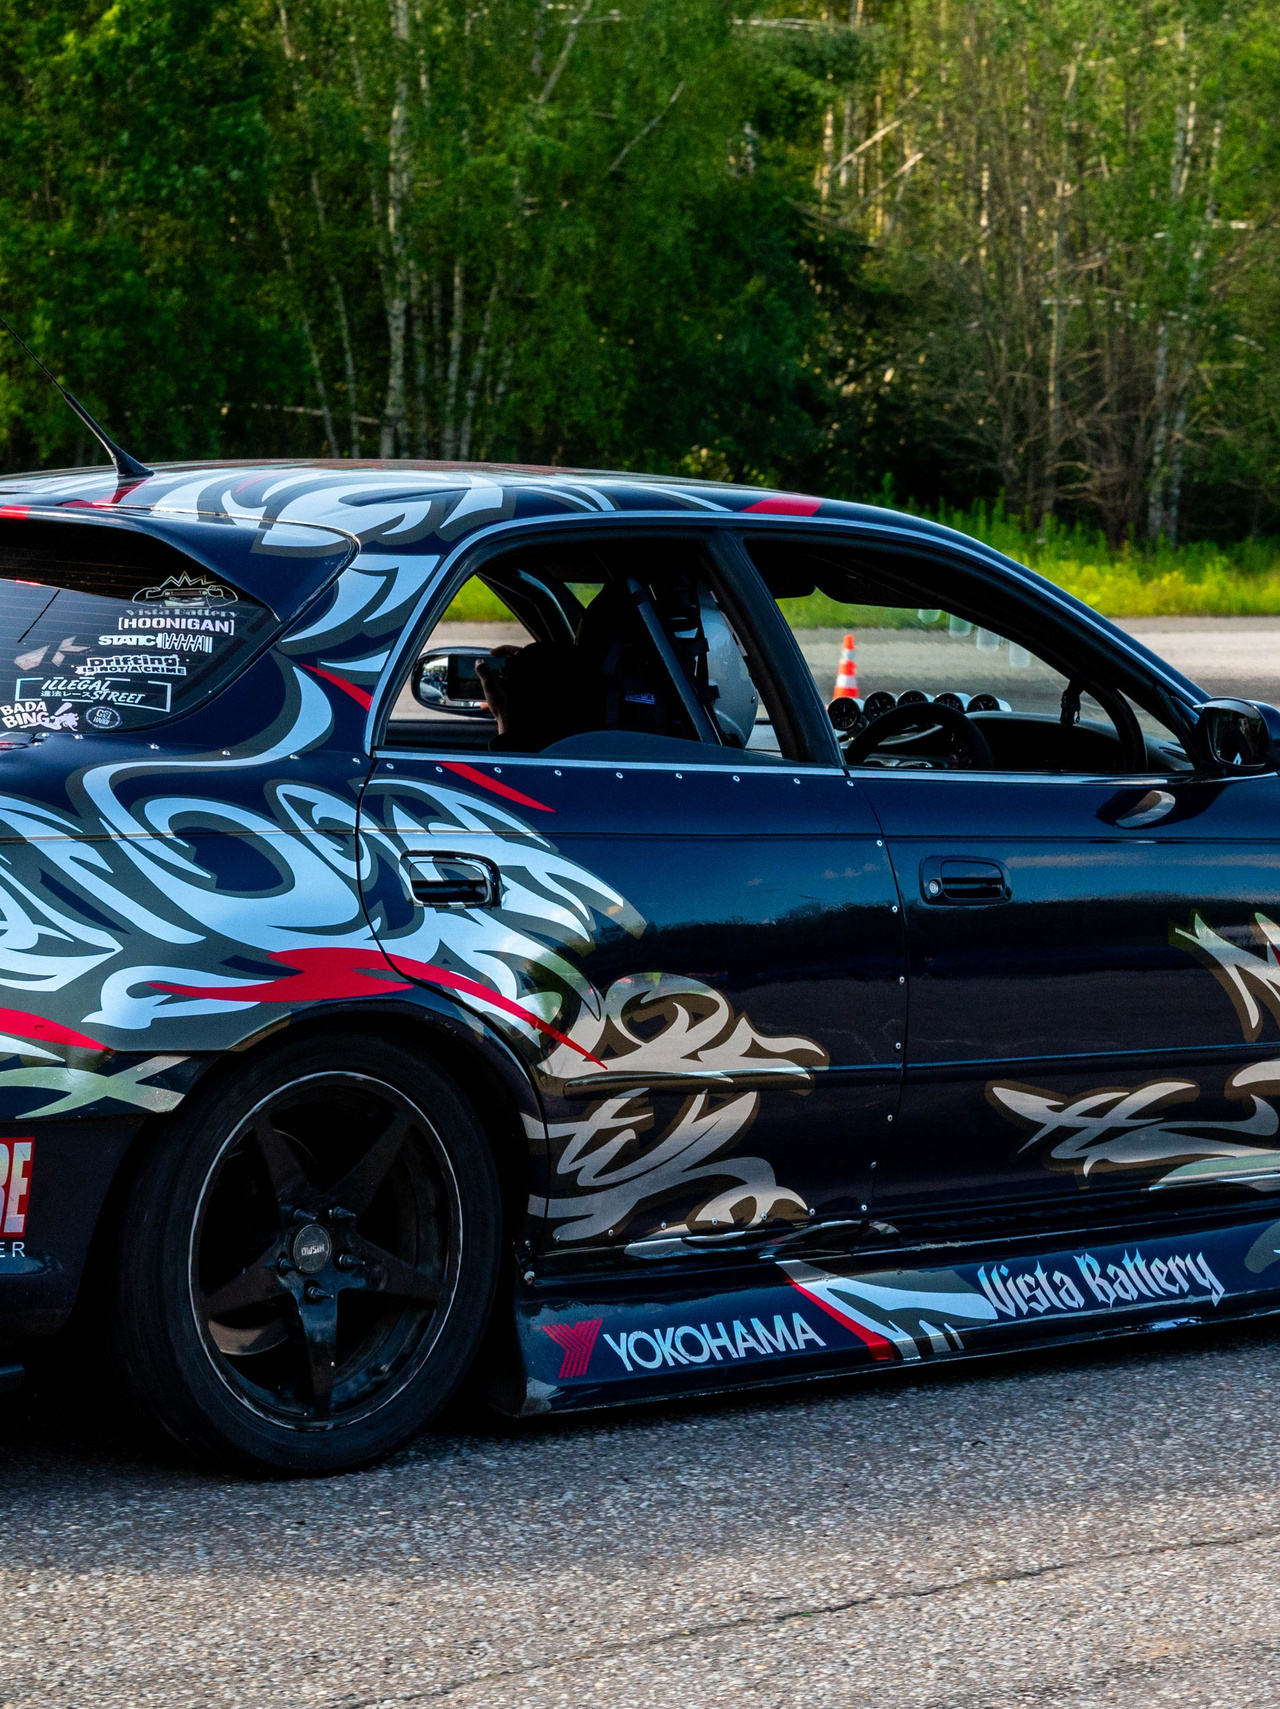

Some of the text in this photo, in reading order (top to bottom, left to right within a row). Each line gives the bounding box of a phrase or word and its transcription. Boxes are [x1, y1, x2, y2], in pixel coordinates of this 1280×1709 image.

[98, 634, 156, 646] STATIC
[89, 656, 178, 667] Drifting
[143, 667, 185, 675] CRIME
[41, 679, 111, 691] ILLEGAL
[90, 690, 146, 704] STREET
[0, 701, 48, 716] BADA
[977, 1247, 1226, 1318] Vista Battery
[602, 1312, 827, 1371] YOKOHAMA
